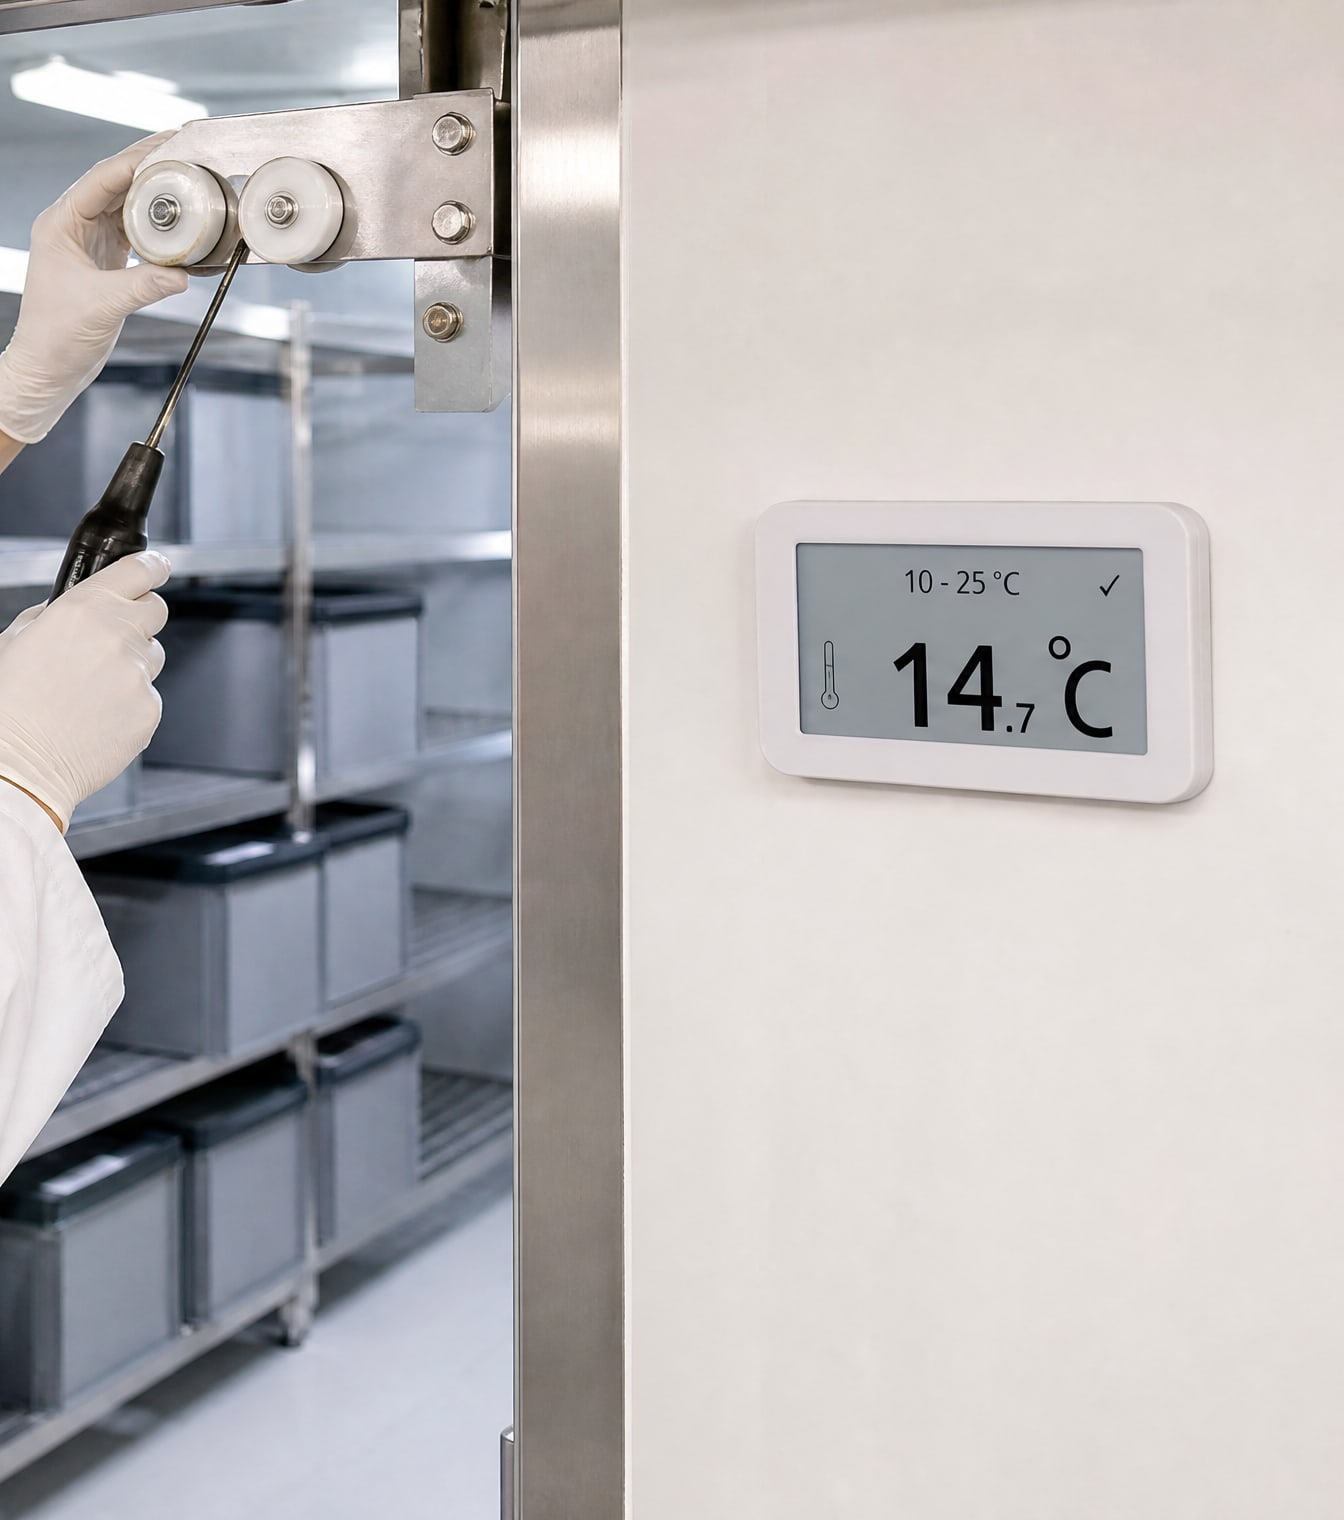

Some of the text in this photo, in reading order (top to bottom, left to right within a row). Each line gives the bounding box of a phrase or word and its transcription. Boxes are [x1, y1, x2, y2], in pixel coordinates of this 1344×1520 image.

[904, 569, 933, 594] 10
[956, 570, 986, 595] 25
[993, 570, 1020, 596] °C
[892, 635, 1114, 739] 14.7 °C
